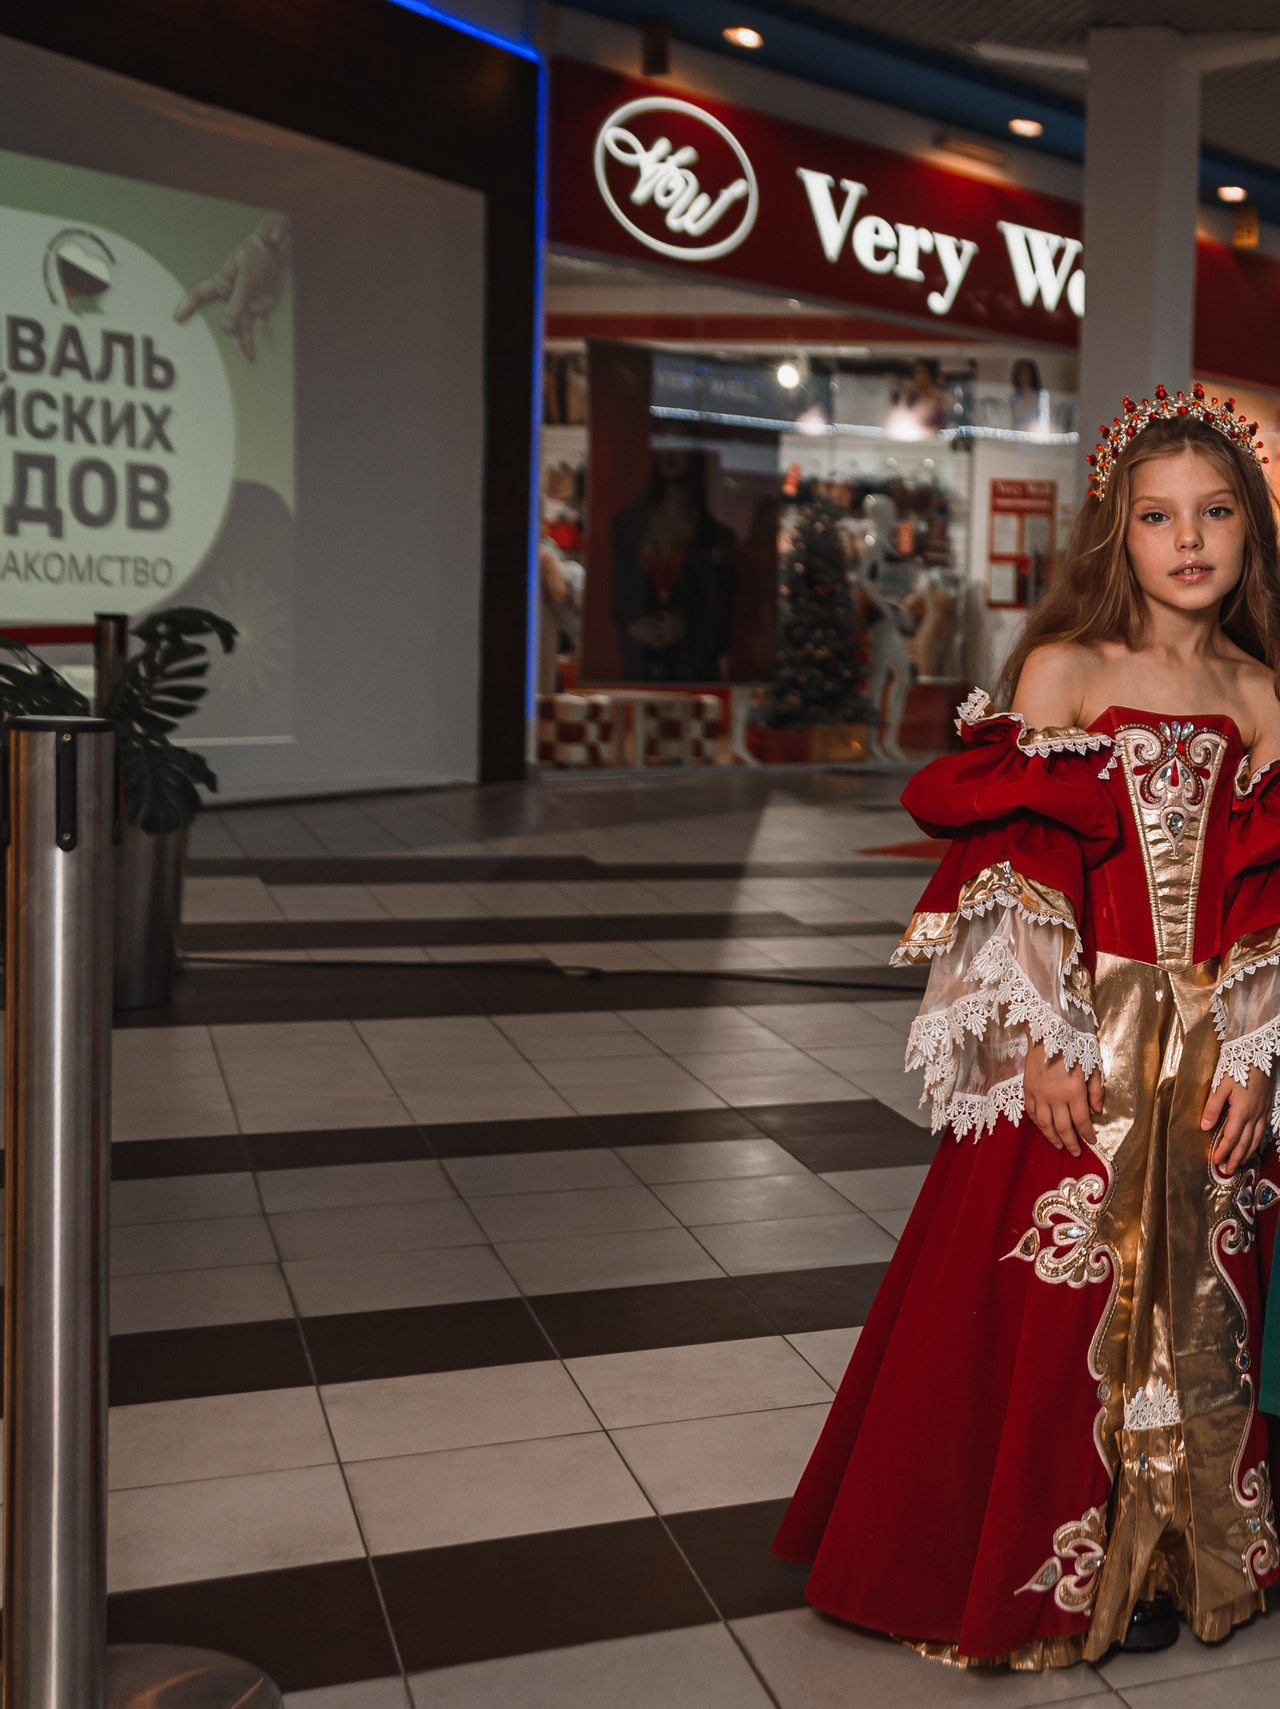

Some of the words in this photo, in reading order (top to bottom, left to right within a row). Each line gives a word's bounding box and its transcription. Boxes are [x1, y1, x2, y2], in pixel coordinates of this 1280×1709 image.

[797, 167, 978, 315] Very
[4, 450, 171, 540] ДОВ
[0, 550, 174, 588] АКОМСТВО
